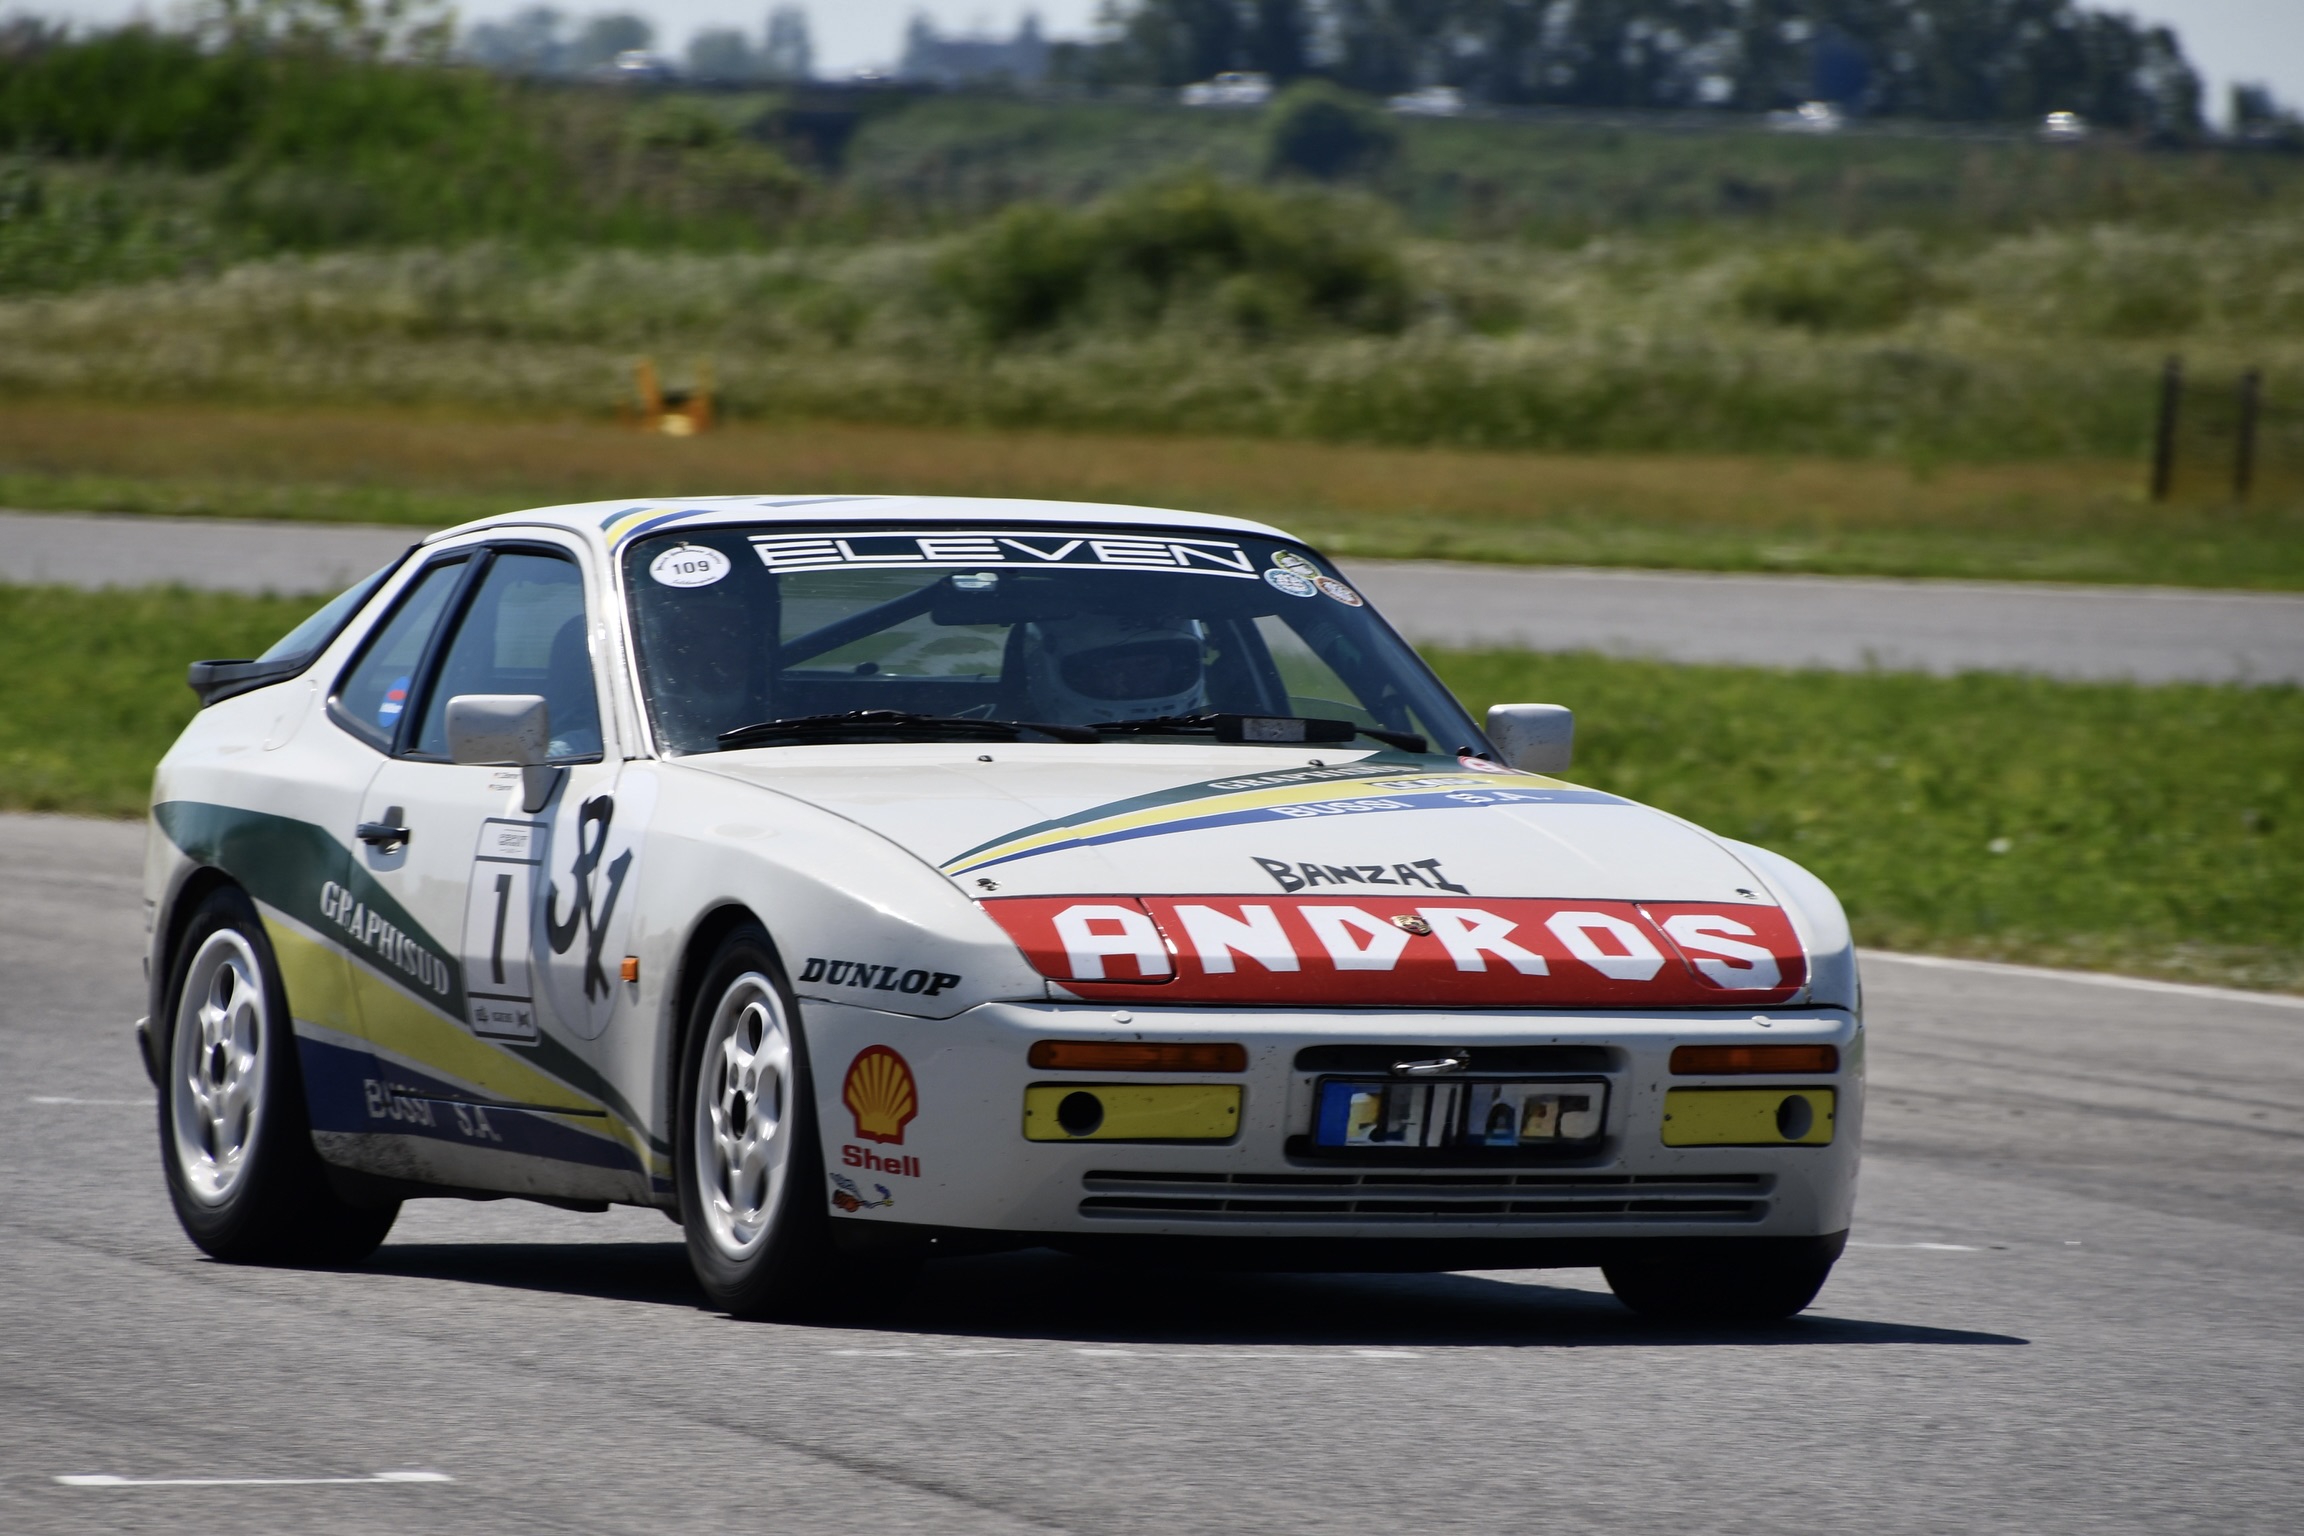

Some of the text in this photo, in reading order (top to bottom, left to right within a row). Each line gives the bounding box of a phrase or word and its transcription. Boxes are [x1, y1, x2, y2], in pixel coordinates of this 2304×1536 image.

[672, 560, 711, 575] 109
[752, 537, 1256, 572] ELEVEN
[1266, 799, 1415, 818] BUSSI
[1250, 856, 1471, 893] BANZAI
[319, 880, 450, 996] GRAPHISUD
[491, 873, 513, 985] 1
[1051, 903, 1783, 991] ANDROS
[798, 957, 961, 997] DUNLOP
[842, 1144, 921, 1178] Shell
